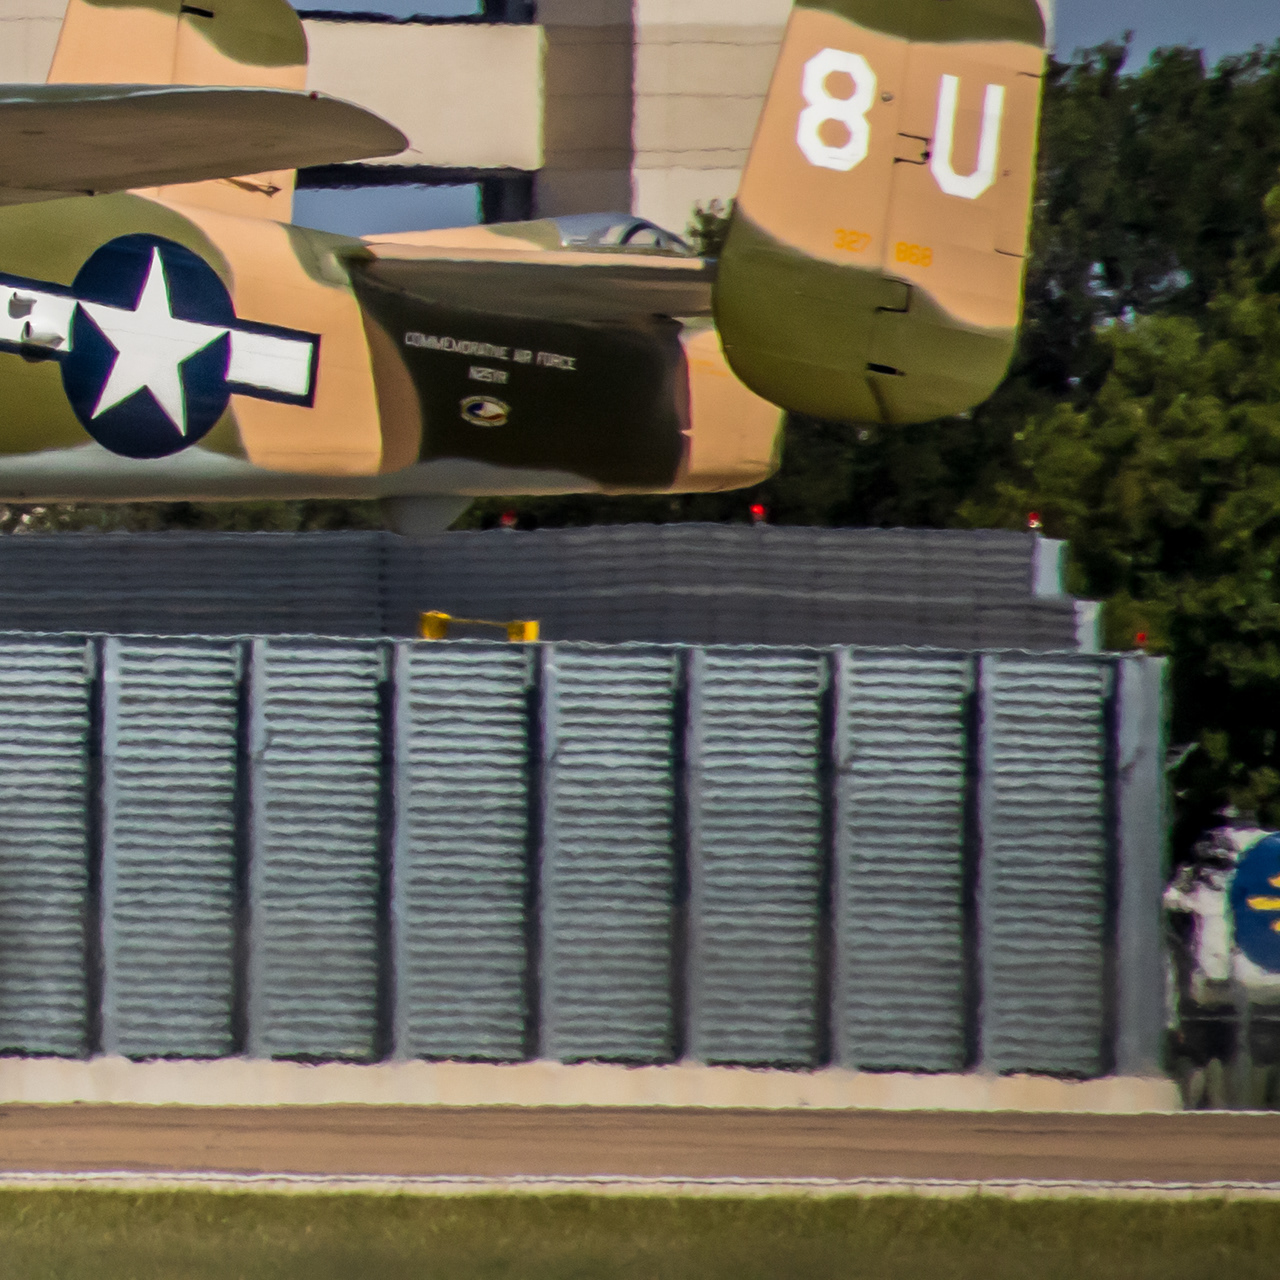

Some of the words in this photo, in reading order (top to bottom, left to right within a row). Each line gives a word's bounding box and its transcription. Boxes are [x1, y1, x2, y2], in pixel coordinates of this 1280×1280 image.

[796, 48, 877, 171] 8
[931, 73, 1005, 200] U
[833, 228, 872, 253] 327
[405, 331, 510, 360] COMMEMORATIVE
[513, 348, 533, 364] AIR
[536, 350, 577, 371] FORCE
